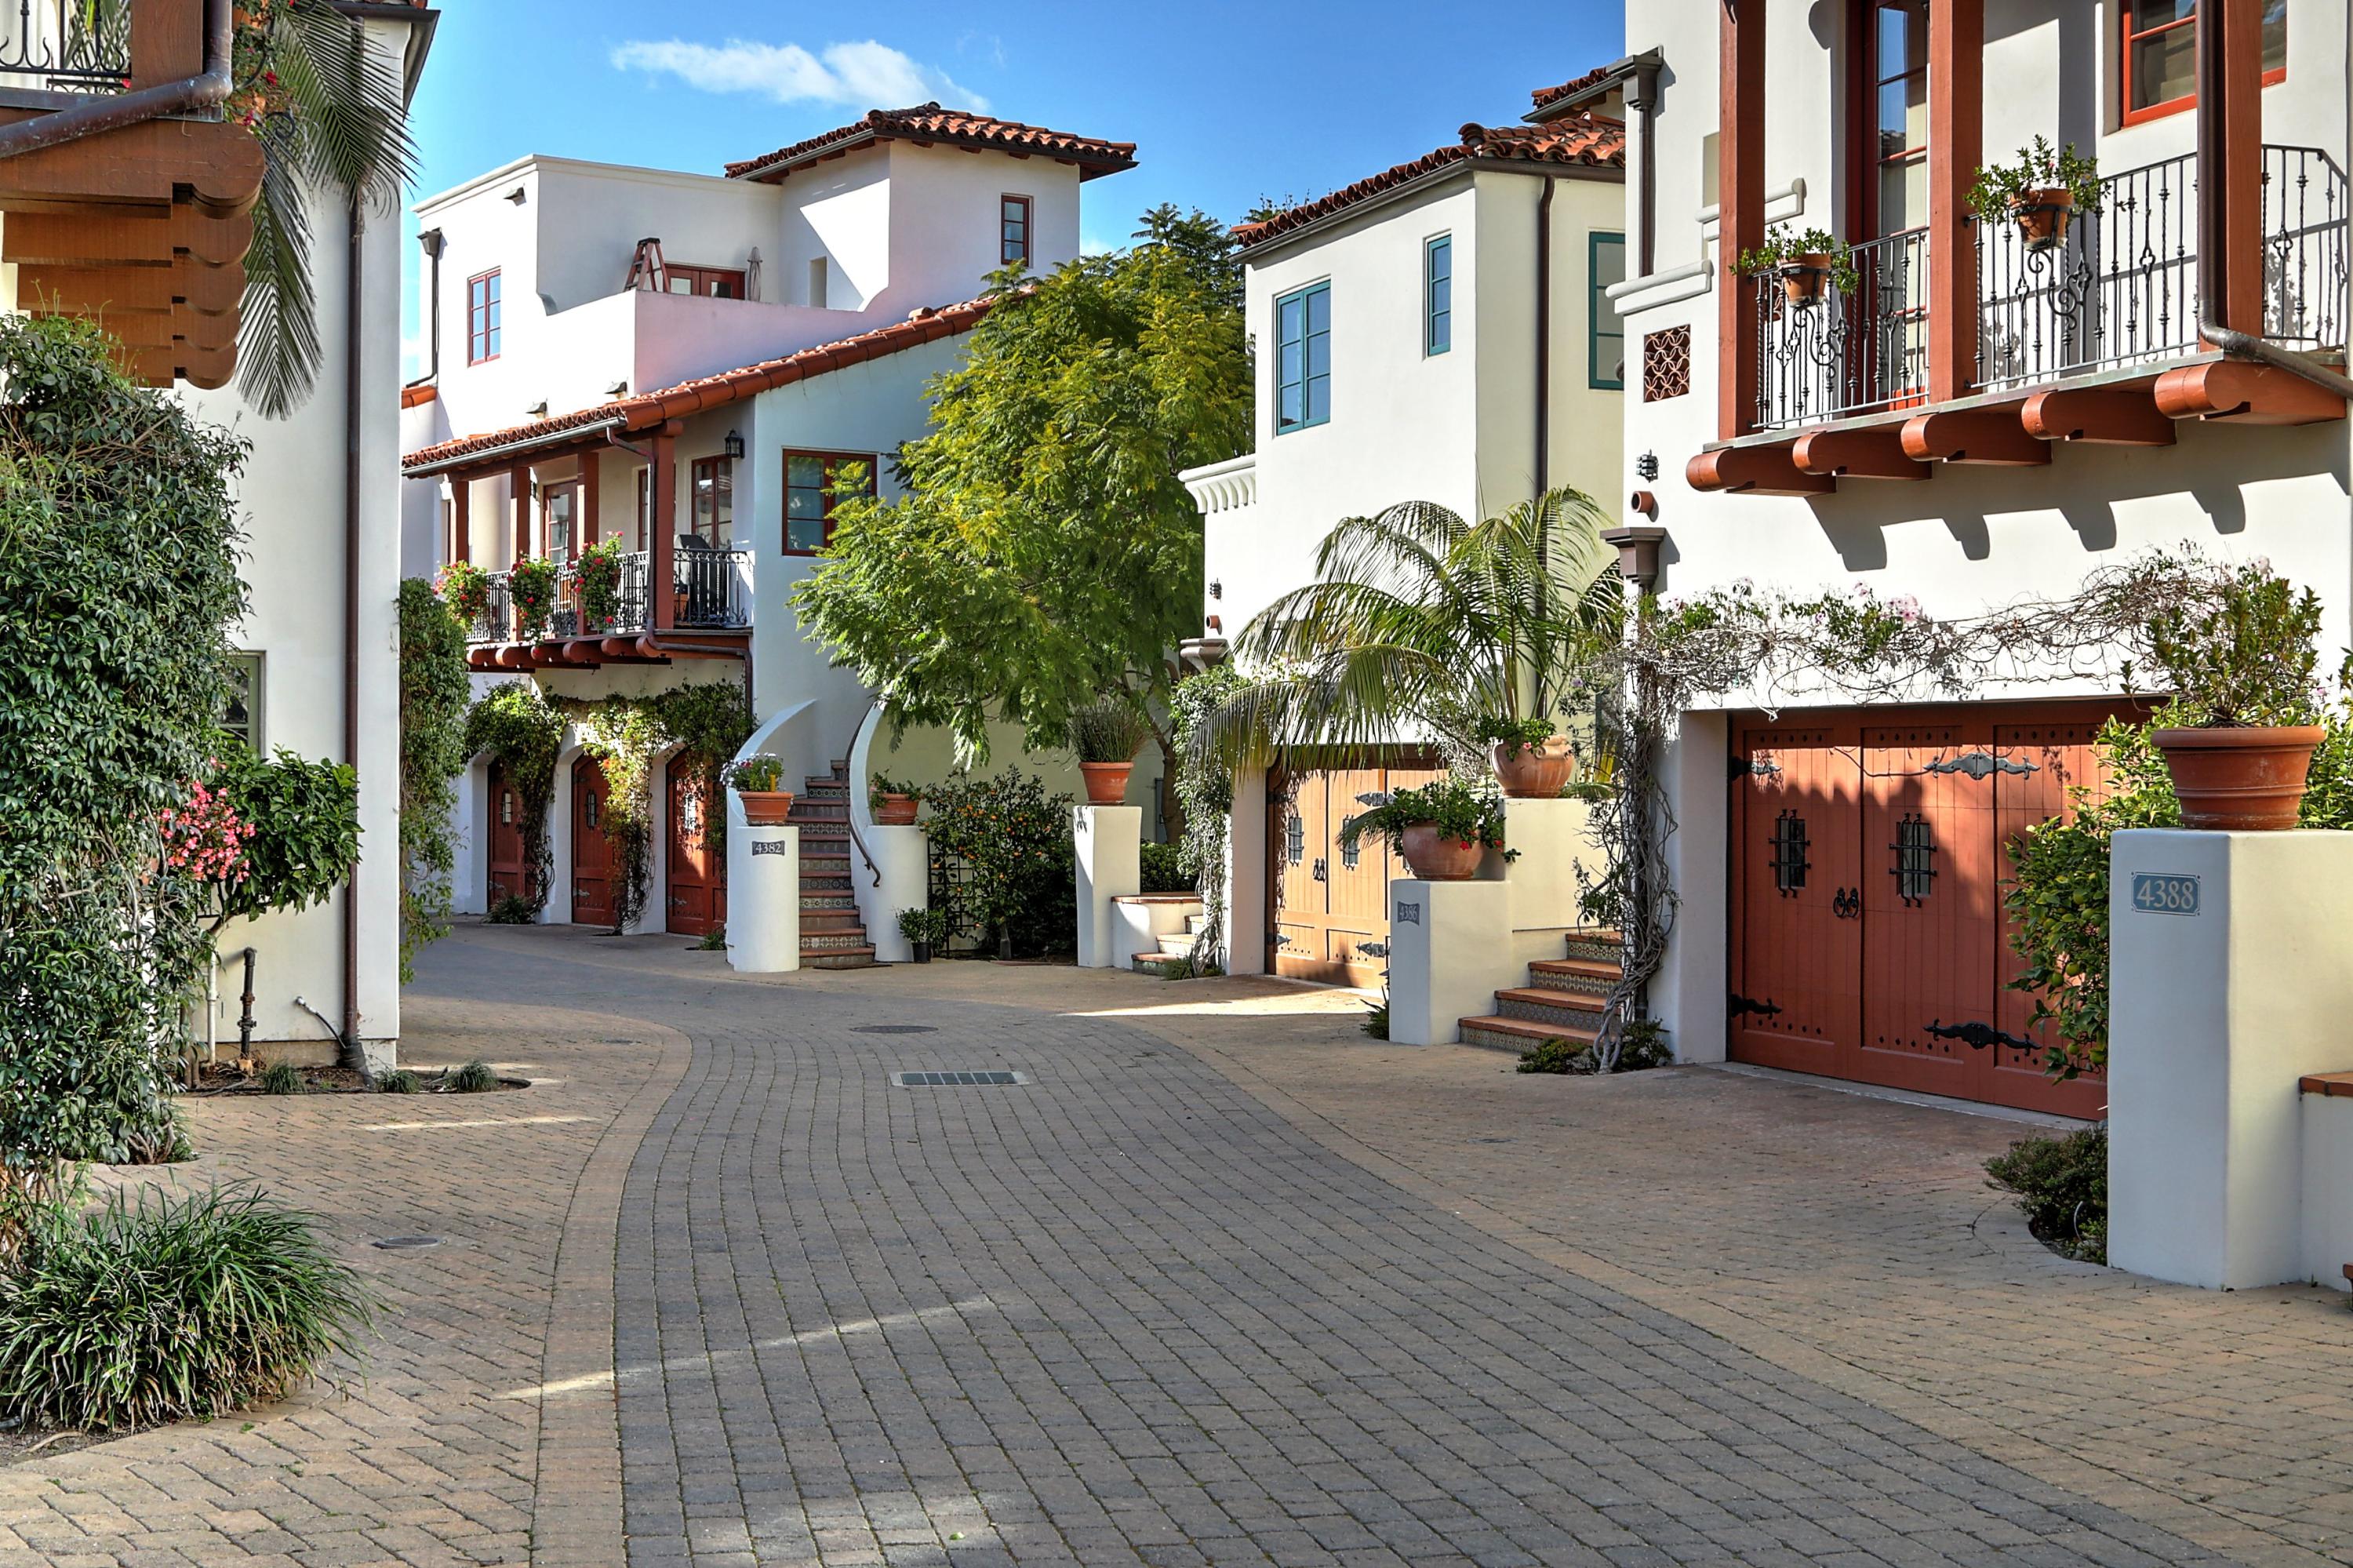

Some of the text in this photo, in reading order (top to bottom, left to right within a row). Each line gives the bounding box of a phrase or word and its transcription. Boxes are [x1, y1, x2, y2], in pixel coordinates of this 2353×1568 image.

[755, 843, 781, 853] 4382
[2137, 879, 2195, 909] 4388
[1399, 905, 1417, 920] 4386
